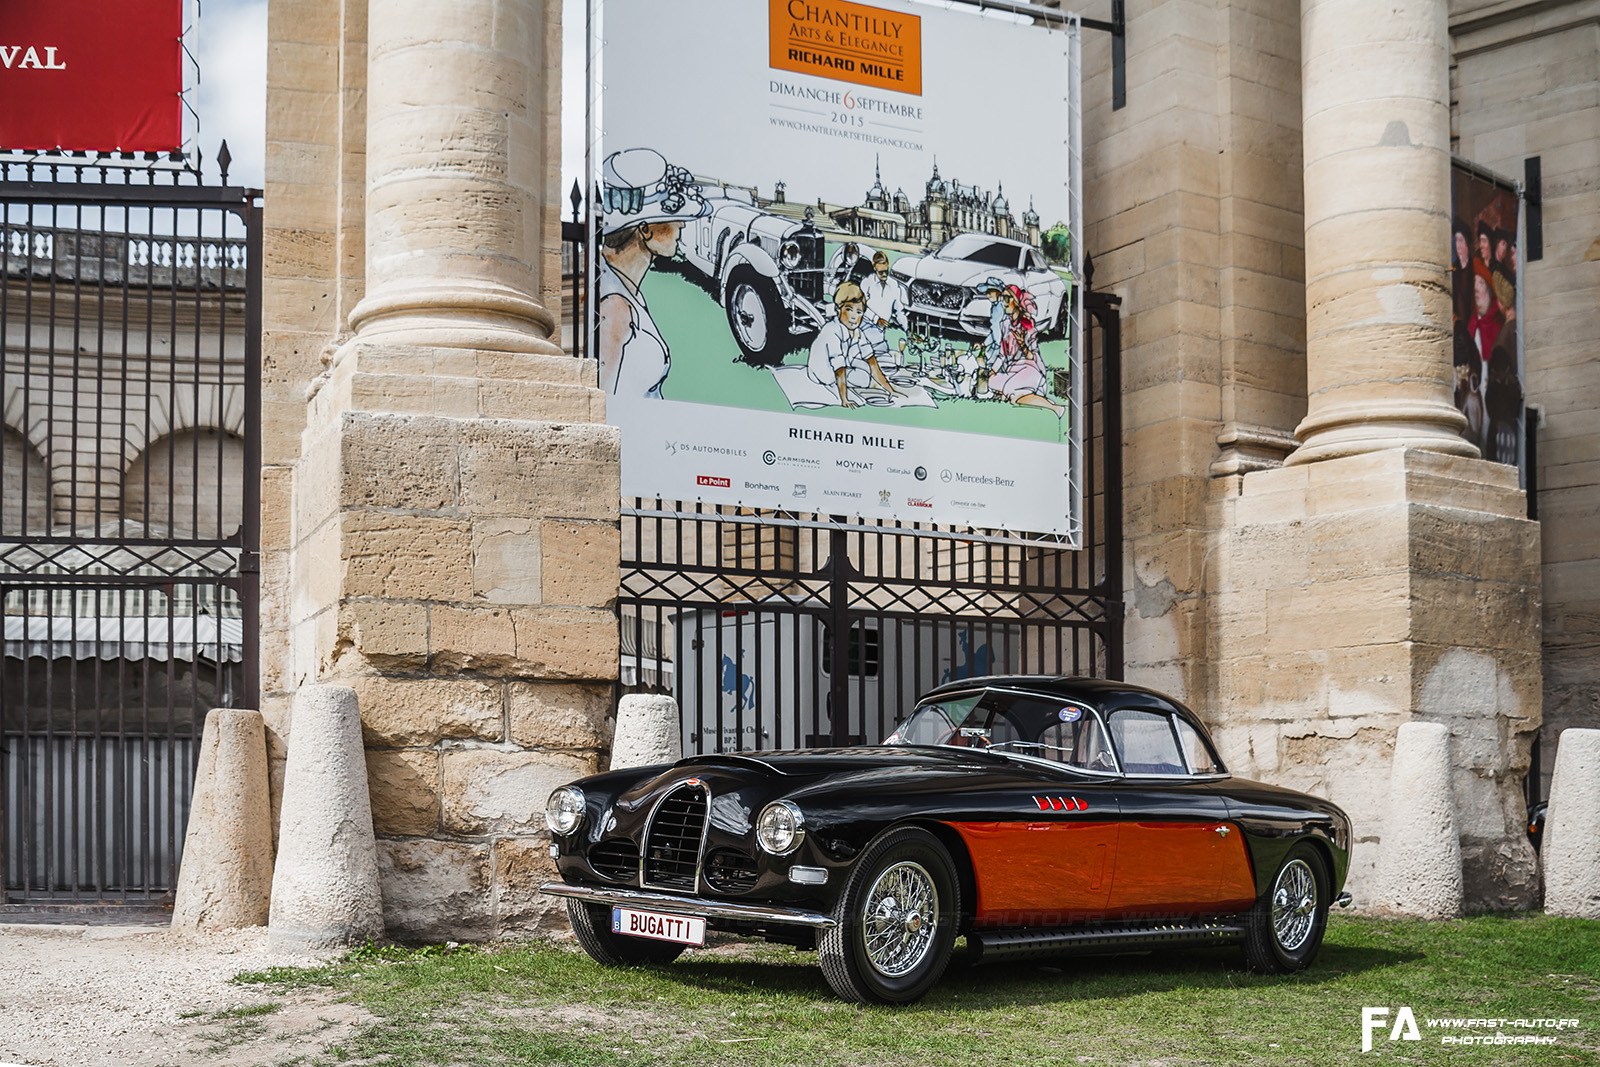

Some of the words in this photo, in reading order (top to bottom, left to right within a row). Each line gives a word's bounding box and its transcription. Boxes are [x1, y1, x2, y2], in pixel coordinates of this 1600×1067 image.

[788, 0, 902, 38] CHANTILLY
[789, 23, 821, 40] ARTS
[825, 30, 834, 42] &
[840, 32, 904, 57] ELEGANCE
[788, 49, 855, 72] RICHARD
[860, 63, 904, 81] MILLE
[769, 80, 841, 105] DIMANCHE
[843, 90, 855, 110] 6
[857, 96, 923, 120] SEPTEMBRE
[831, 112, 864, 128] 2015
[789, 428, 854, 444] RICHARD
[862, 436, 905, 450] MILLE
[692, 445, 747, 457] AUTOMOBILES
[777, 456, 820, 465] CARMIGNAC
[836, 460, 873, 470] MOYNAT
[699, 477, 708, 485] Le
[709, 478, 728, 487] Point
[744, 482, 780, 492] Bonhams
[955, 472, 1014, 487] Mercedes-Benz
[614, 921, 620, 930] B
[630, 913, 691, 939] BUGATTI
